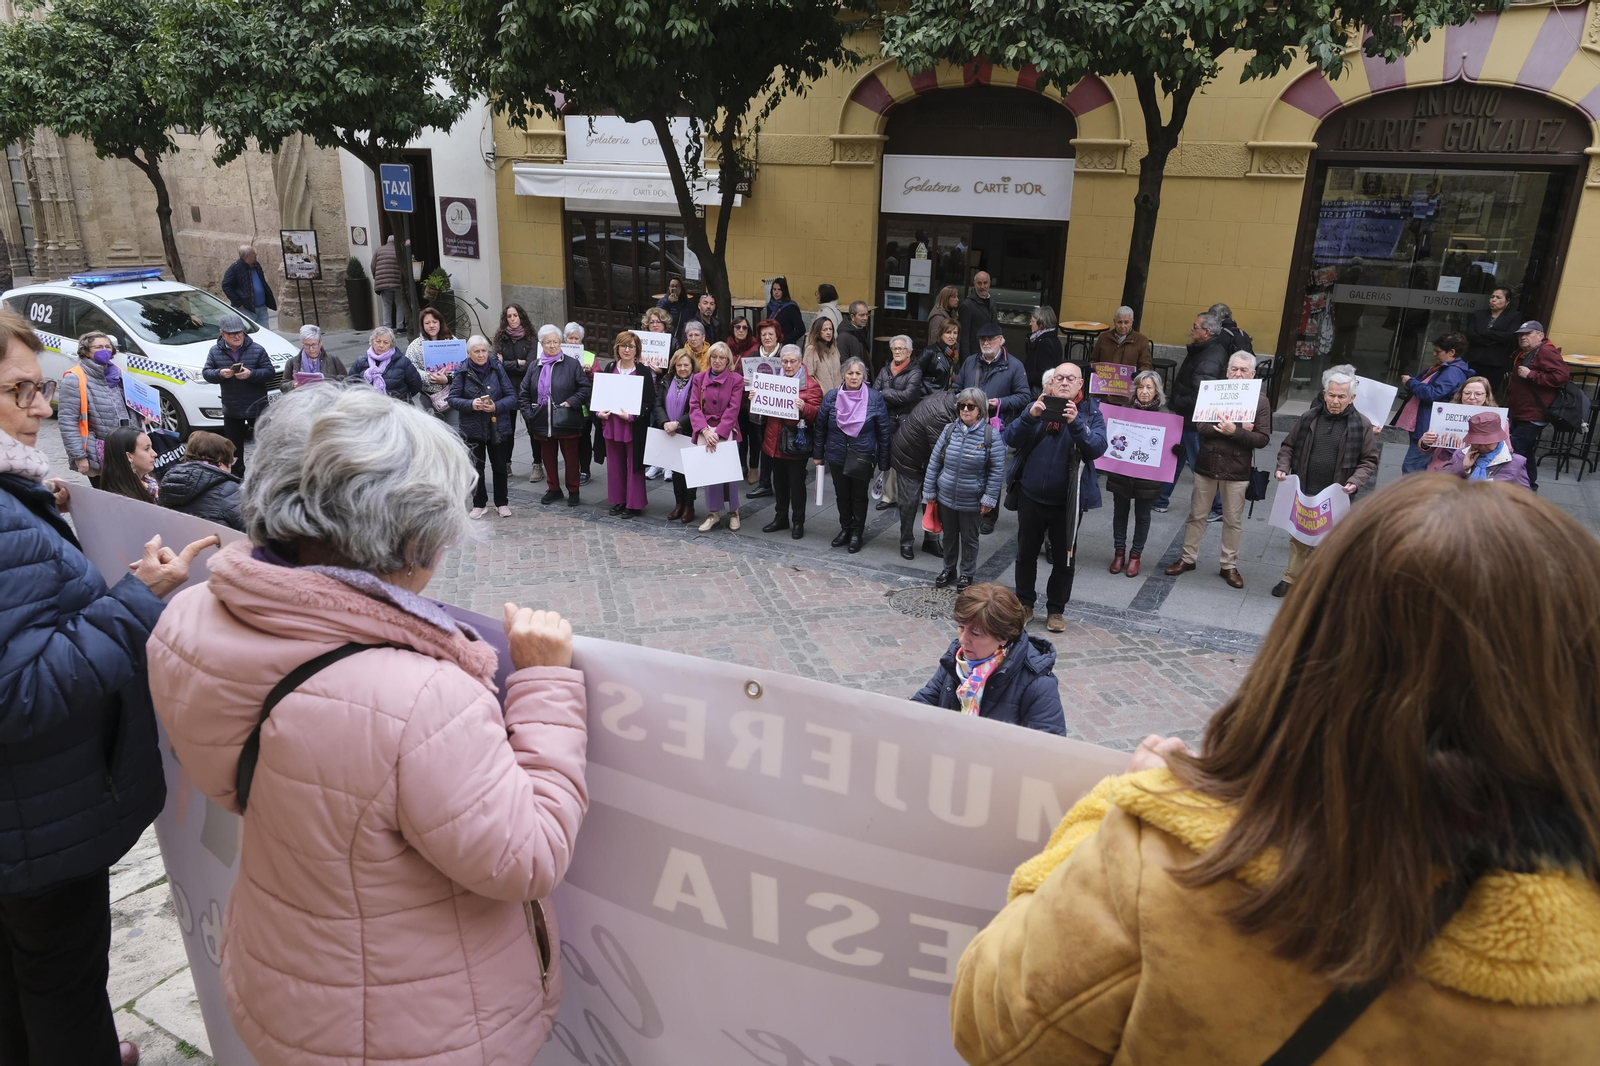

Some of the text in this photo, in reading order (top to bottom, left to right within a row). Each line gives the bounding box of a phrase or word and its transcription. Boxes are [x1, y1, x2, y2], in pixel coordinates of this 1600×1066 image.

[1415, 87, 1500, 117] ANTONIO
[586, 133, 630, 147] Gelateria
[1338, 118, 1567, 151] ADARVE GONZALEZ
[383, 180, 411, 196] TAXI
[577, 182, 619, 196] Gelateria
[633, 188, 652, 196] CARTE
[903, 176, 1046, 196] Gelateria CARTE D'OR
[1349, 289, 1476, 308] GALERÍAS TURÍSTICAS
[30, 302, 53, 324] 092
[753, 381, 797, 394] QUEREMOS
[1214, 383, 1250, 391] VENIMOS DE
[754, 395, 794, 409] ASUMIR
[1220, 392, 1239, 400] LEJOS
[752, 407, 797, 418] RESPONSABILIDADES
